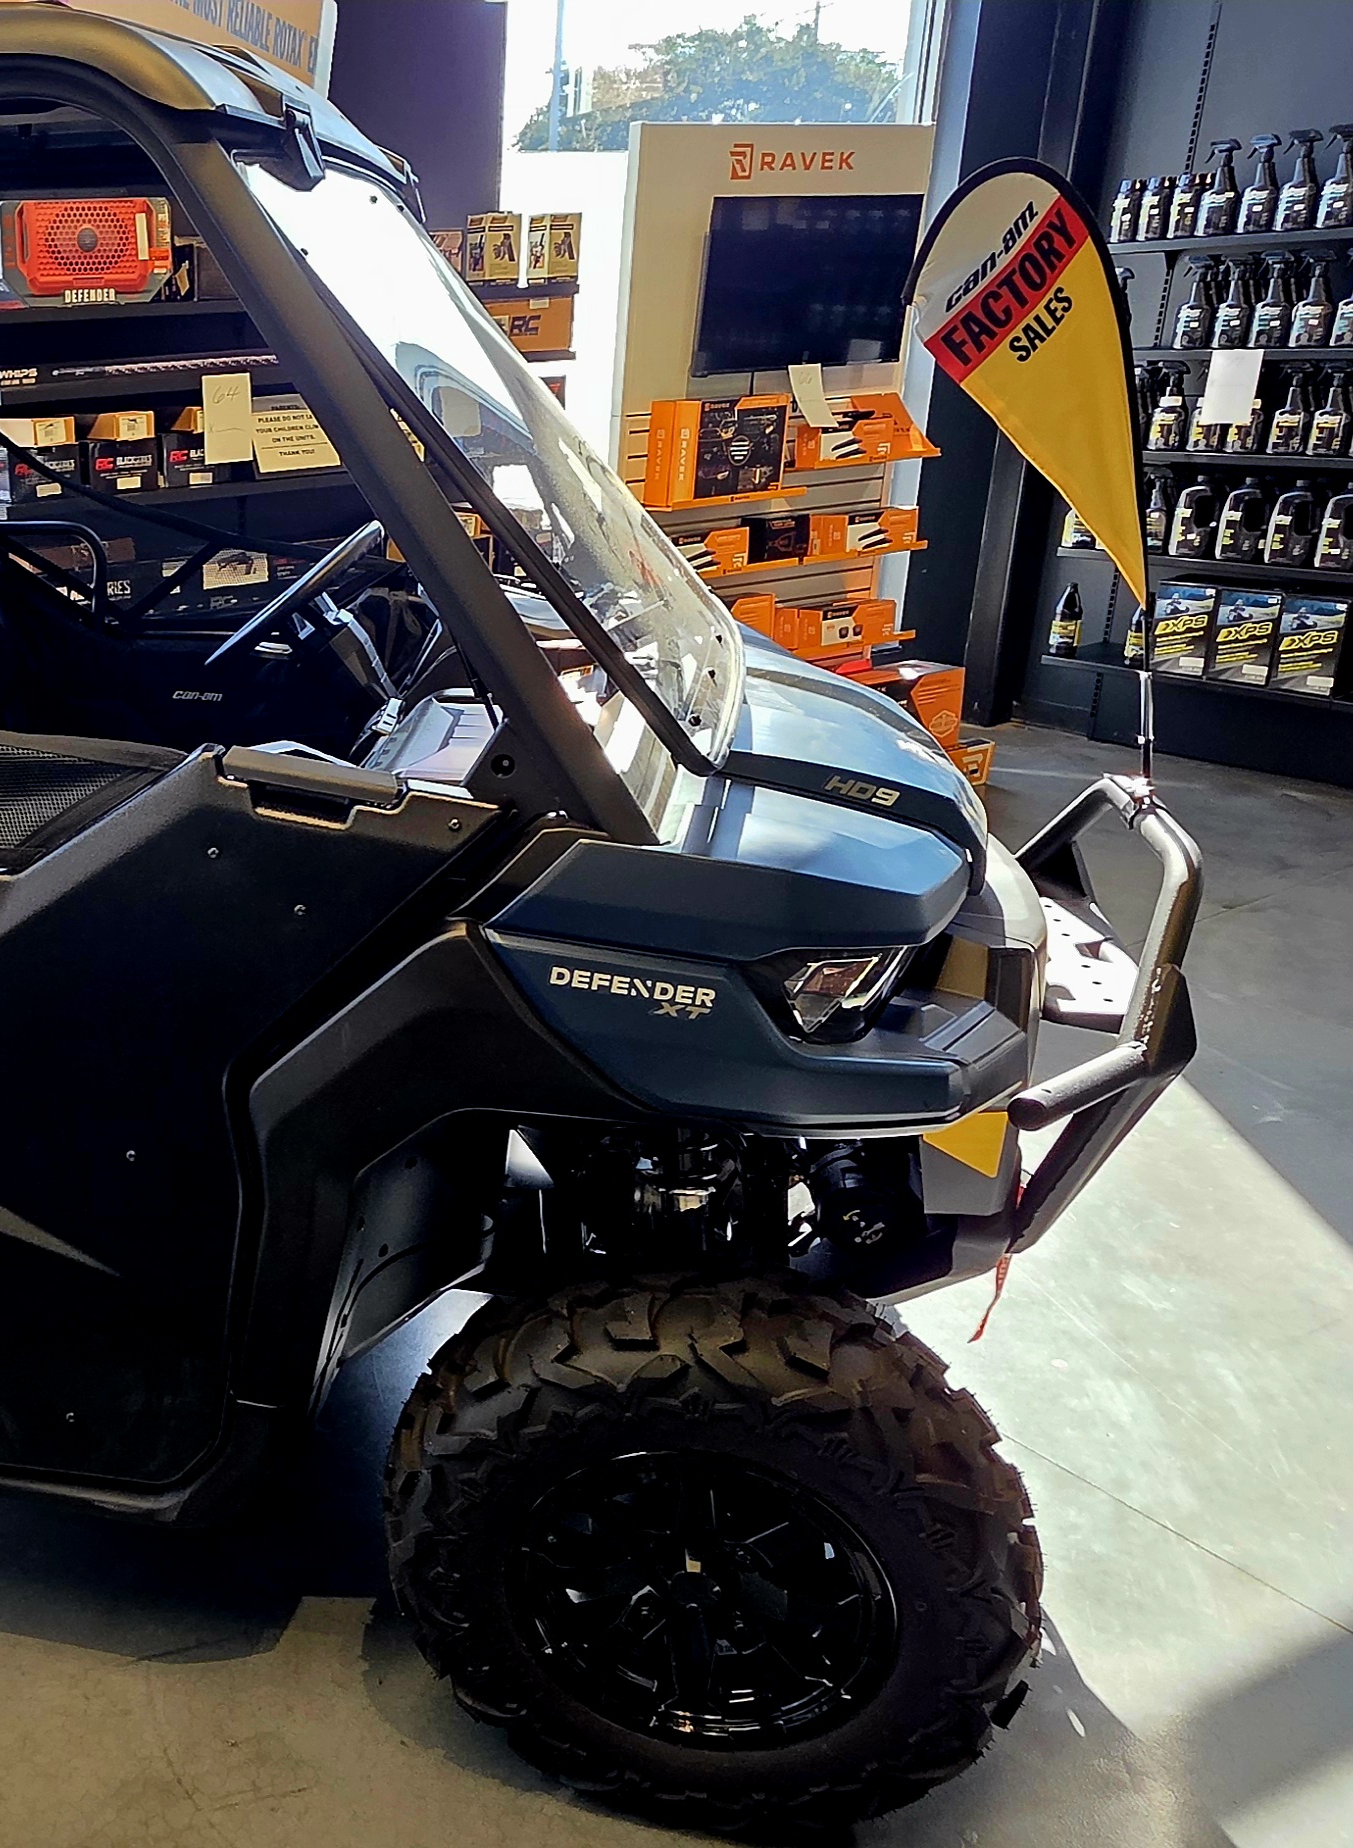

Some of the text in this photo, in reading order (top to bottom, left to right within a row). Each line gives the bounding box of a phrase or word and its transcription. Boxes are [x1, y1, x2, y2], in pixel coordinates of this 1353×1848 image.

[227, 0, 273, 53] RELIABLE
[759, 151, 856, 172] RAVEK
[64, 287, 116, 303] DEFENDER
[940, 207, 1077, 368] FACTORY
[1008, 286, 1073, 363] SALES
[258, 415, 281, 423] PLEASE
[273, 425, 304, 433] CHILDREN
[1164, 614, 1209, 633] XPS
[1227, 621, 1273, 640] XPS
[1290, 630, 1339, 649] XPS
[824, 774, 901, 807] HD9
[549, 965, 717, 1008] DEFENDER
[652, 1001, 712, 1020] XT
